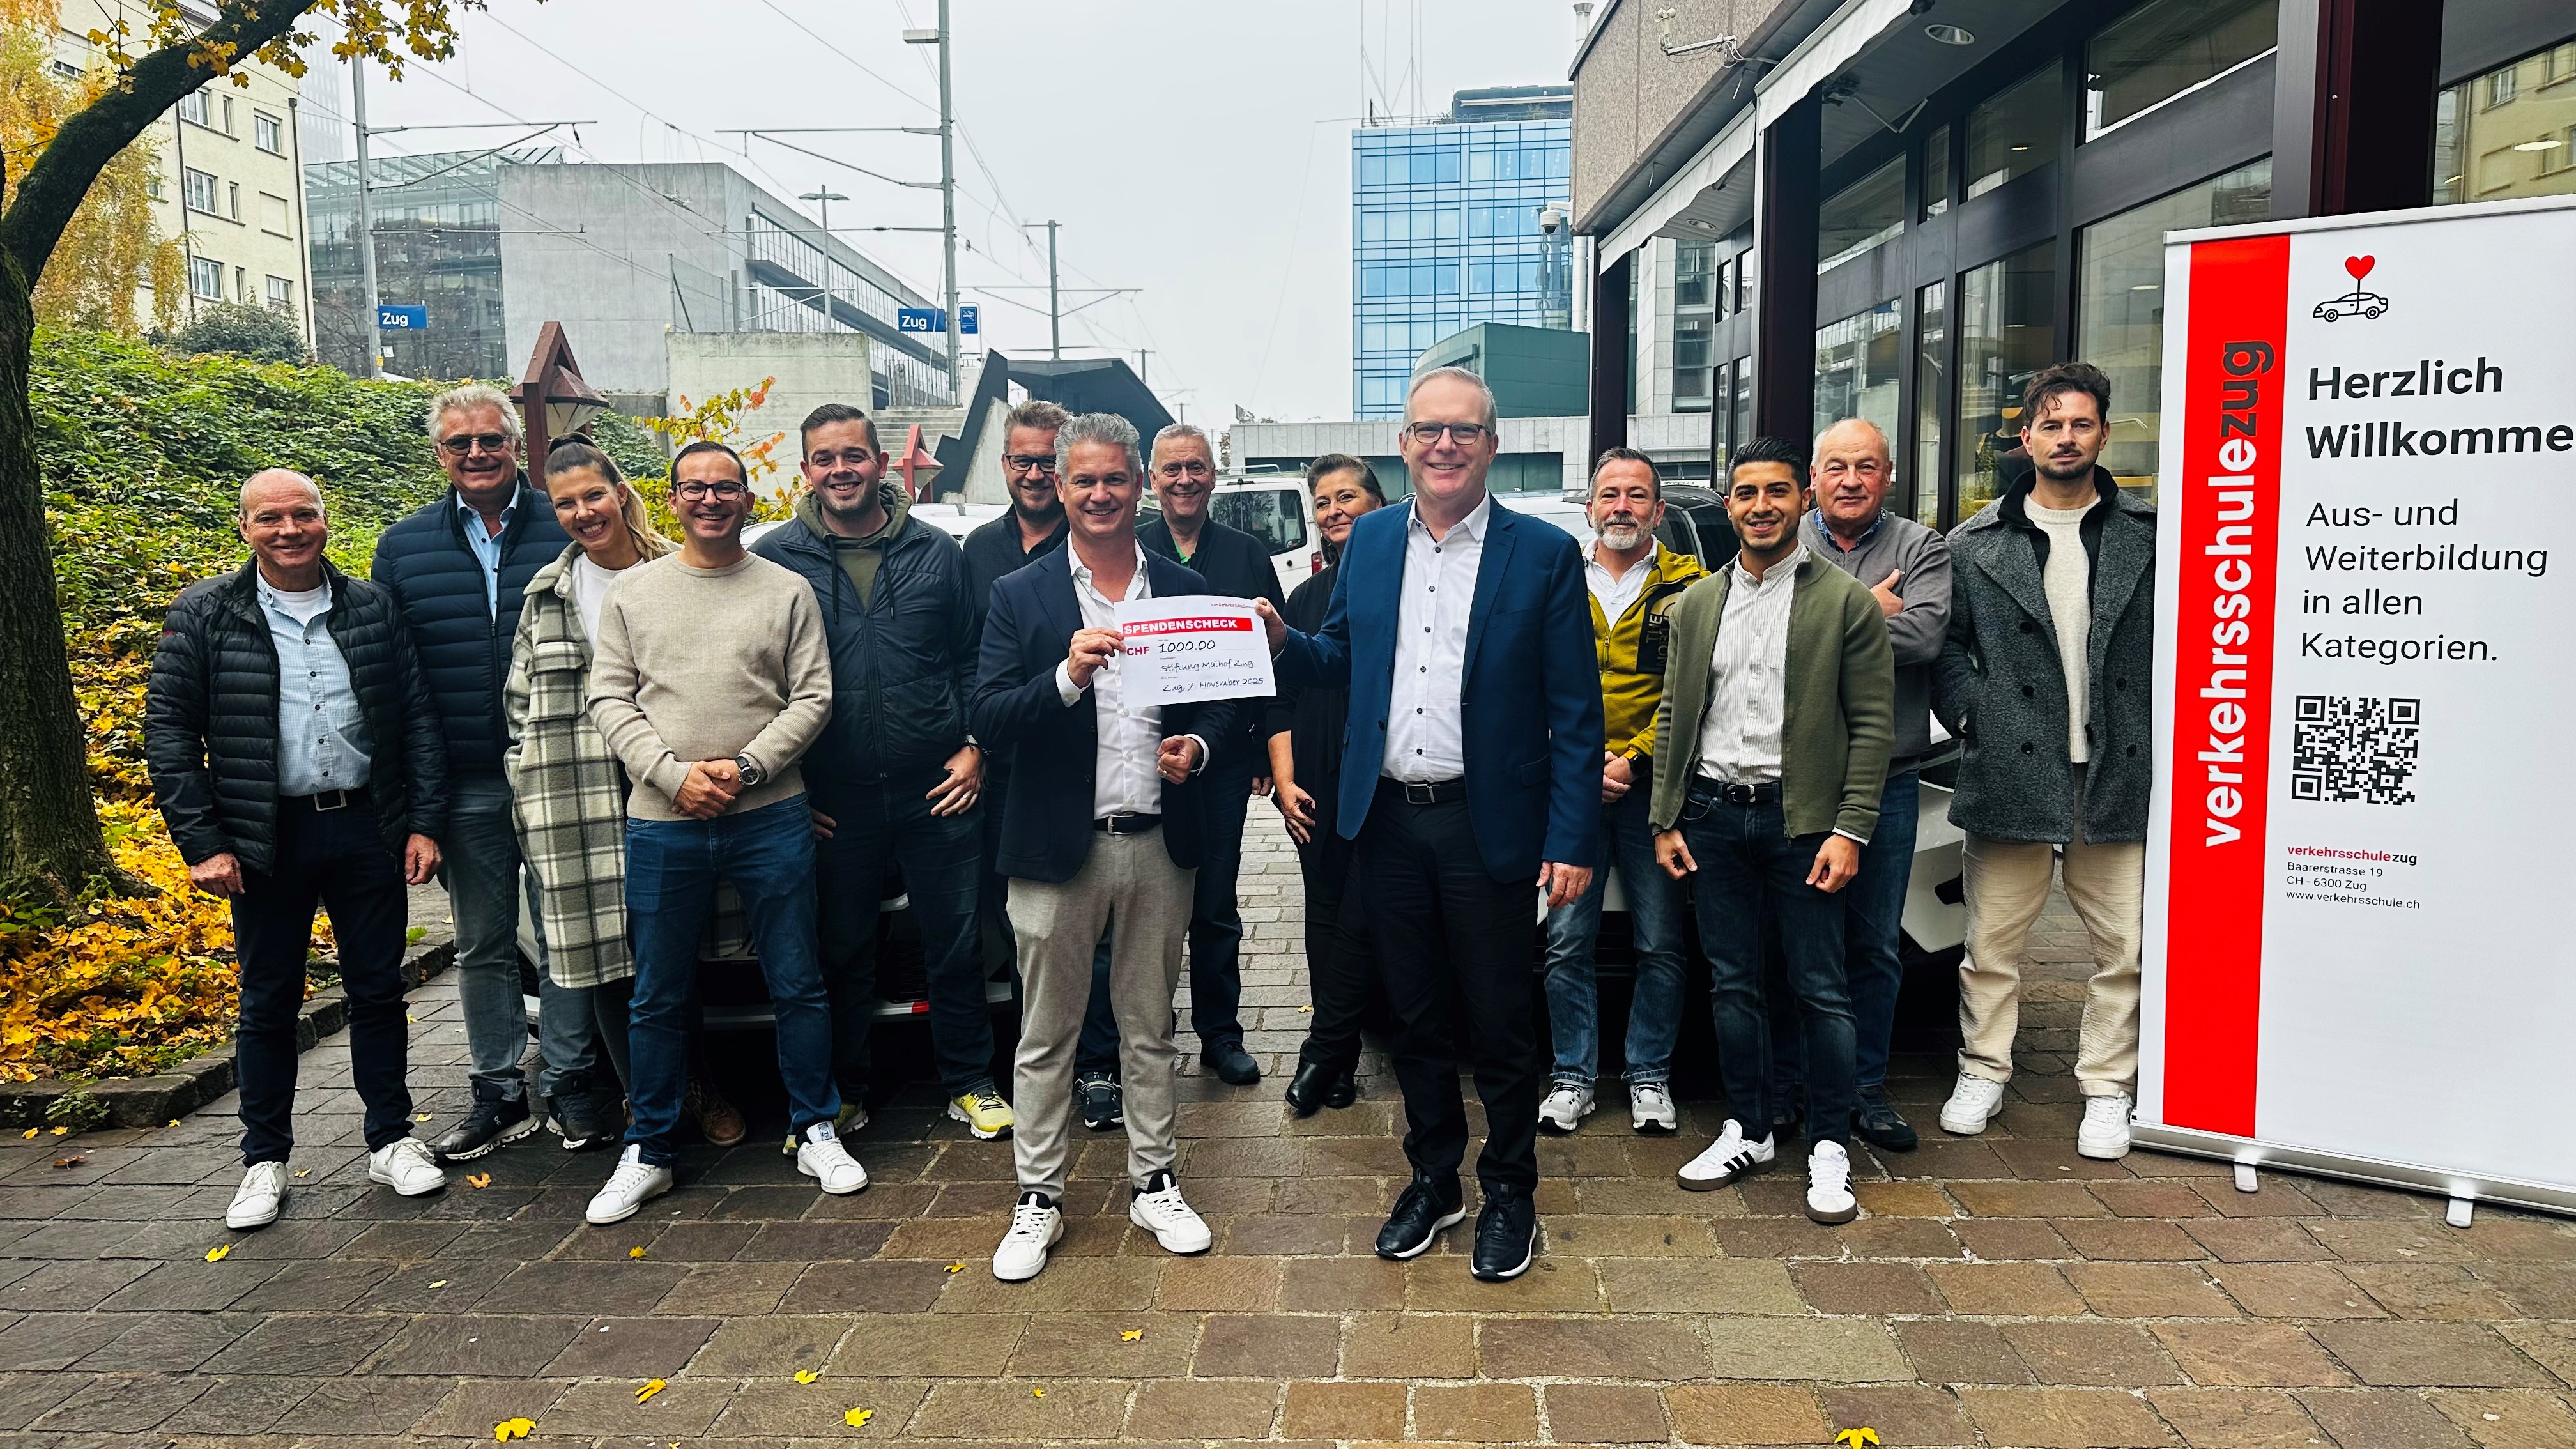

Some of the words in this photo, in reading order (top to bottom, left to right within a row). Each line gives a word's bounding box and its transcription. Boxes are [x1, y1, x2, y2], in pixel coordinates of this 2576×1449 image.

[382, 312, 408, 327] Zug
[901, 316, 927, 330] Zug
[2308, 356, 2503, 401] Herzlich
[2305, 502, 2382, 527] Aus-
[2395, 498, 2458, 526] und
[2305, 543, 2547, 578] Weiterbildung
[2198, 341, 2274, 847] verkehrsschulezug
[2303, 589, 2330, 614] in
[2343, 588, 2422, 615] allen
[1124, 618, 1238, 634] SPENDENSCHECK
[1646, 614, 1662, 643] THE
[1126, 646, 1150, 656] CHF
[1158, 640, 1215, 653] 1000.00
[2301, 632, 2498, 666] Kategorien.
[1160, 662, 1200, 673] Stiftung
[1202, 659, 1232, 669] Maihof
[1234, 659, 1254, 668] Zug
[1199, 678, 1241, 689] November
[1241, 677, 1264, 686] 2025
[2287, 845, 2418, 866] verkehrsschulezug
[2287, 861, 2366, 876] Baarerstrasse
[2369, 868, 2383, 877] 19
[2287, 875, 2303, 885] CH
[2313, 878, 2342, 888] 6300
[2345, 880, 2366, 892] Zug
[2286, 891, 2420, 909] www.verkehrsschule.ch
